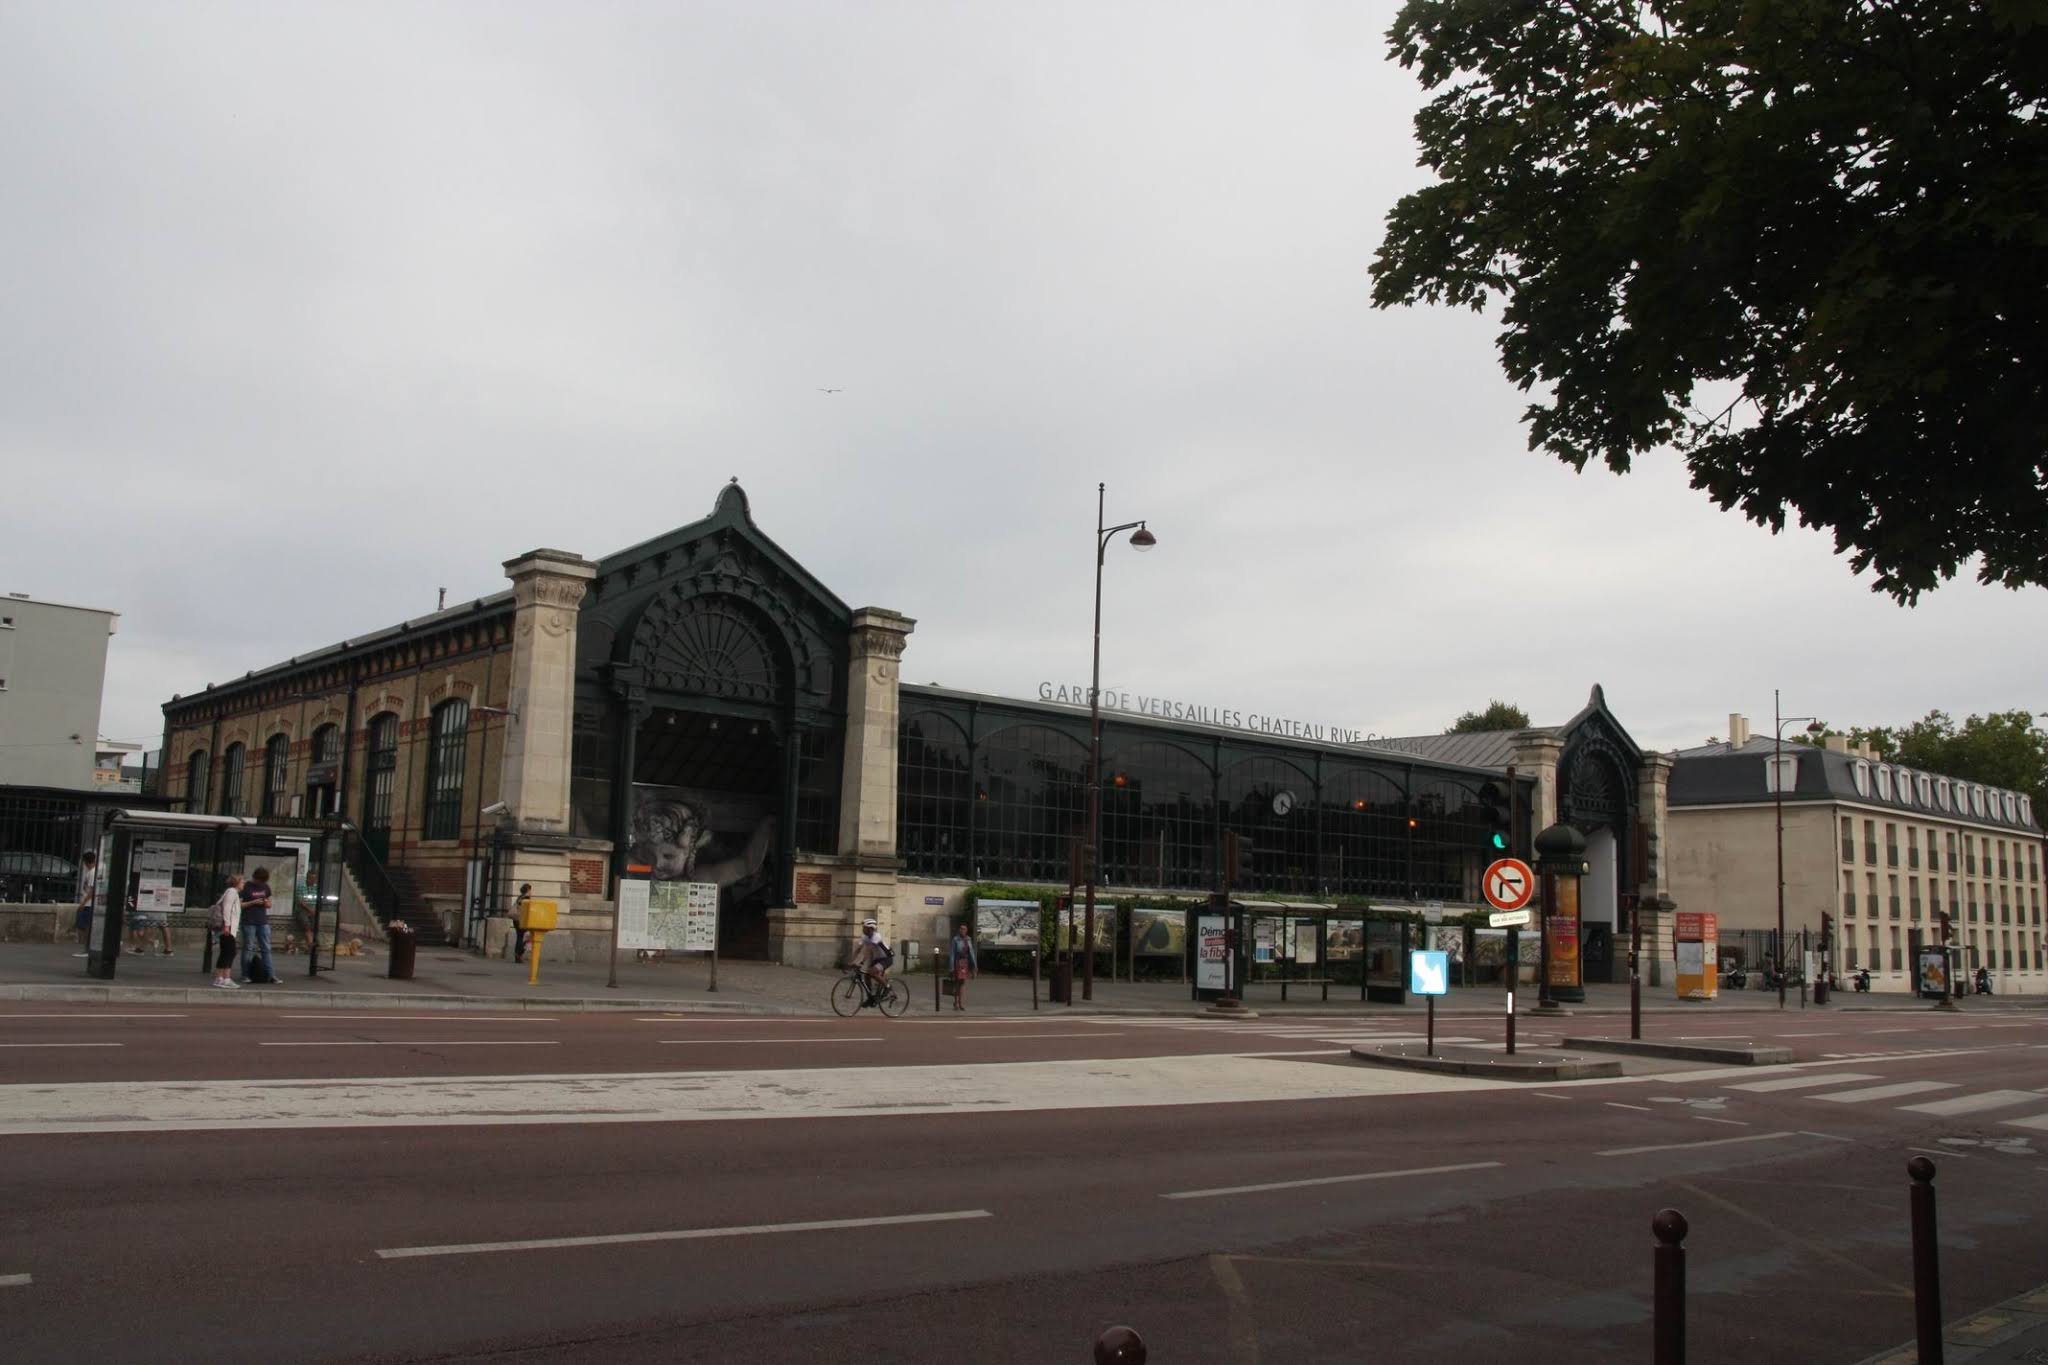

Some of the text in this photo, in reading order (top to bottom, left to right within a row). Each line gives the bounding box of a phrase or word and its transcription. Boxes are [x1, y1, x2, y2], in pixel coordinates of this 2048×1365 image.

[1038, 681, 1094, 706] GARE
[1105, 690, 1131, 711] DE
[1137, 695, 1241, 728] VERSAILLES
[1248, 714, 1324, 740] CHATEAU
[1331, 727, 1361, 744] RIVE
[1199, 947, 1208, 959] la
